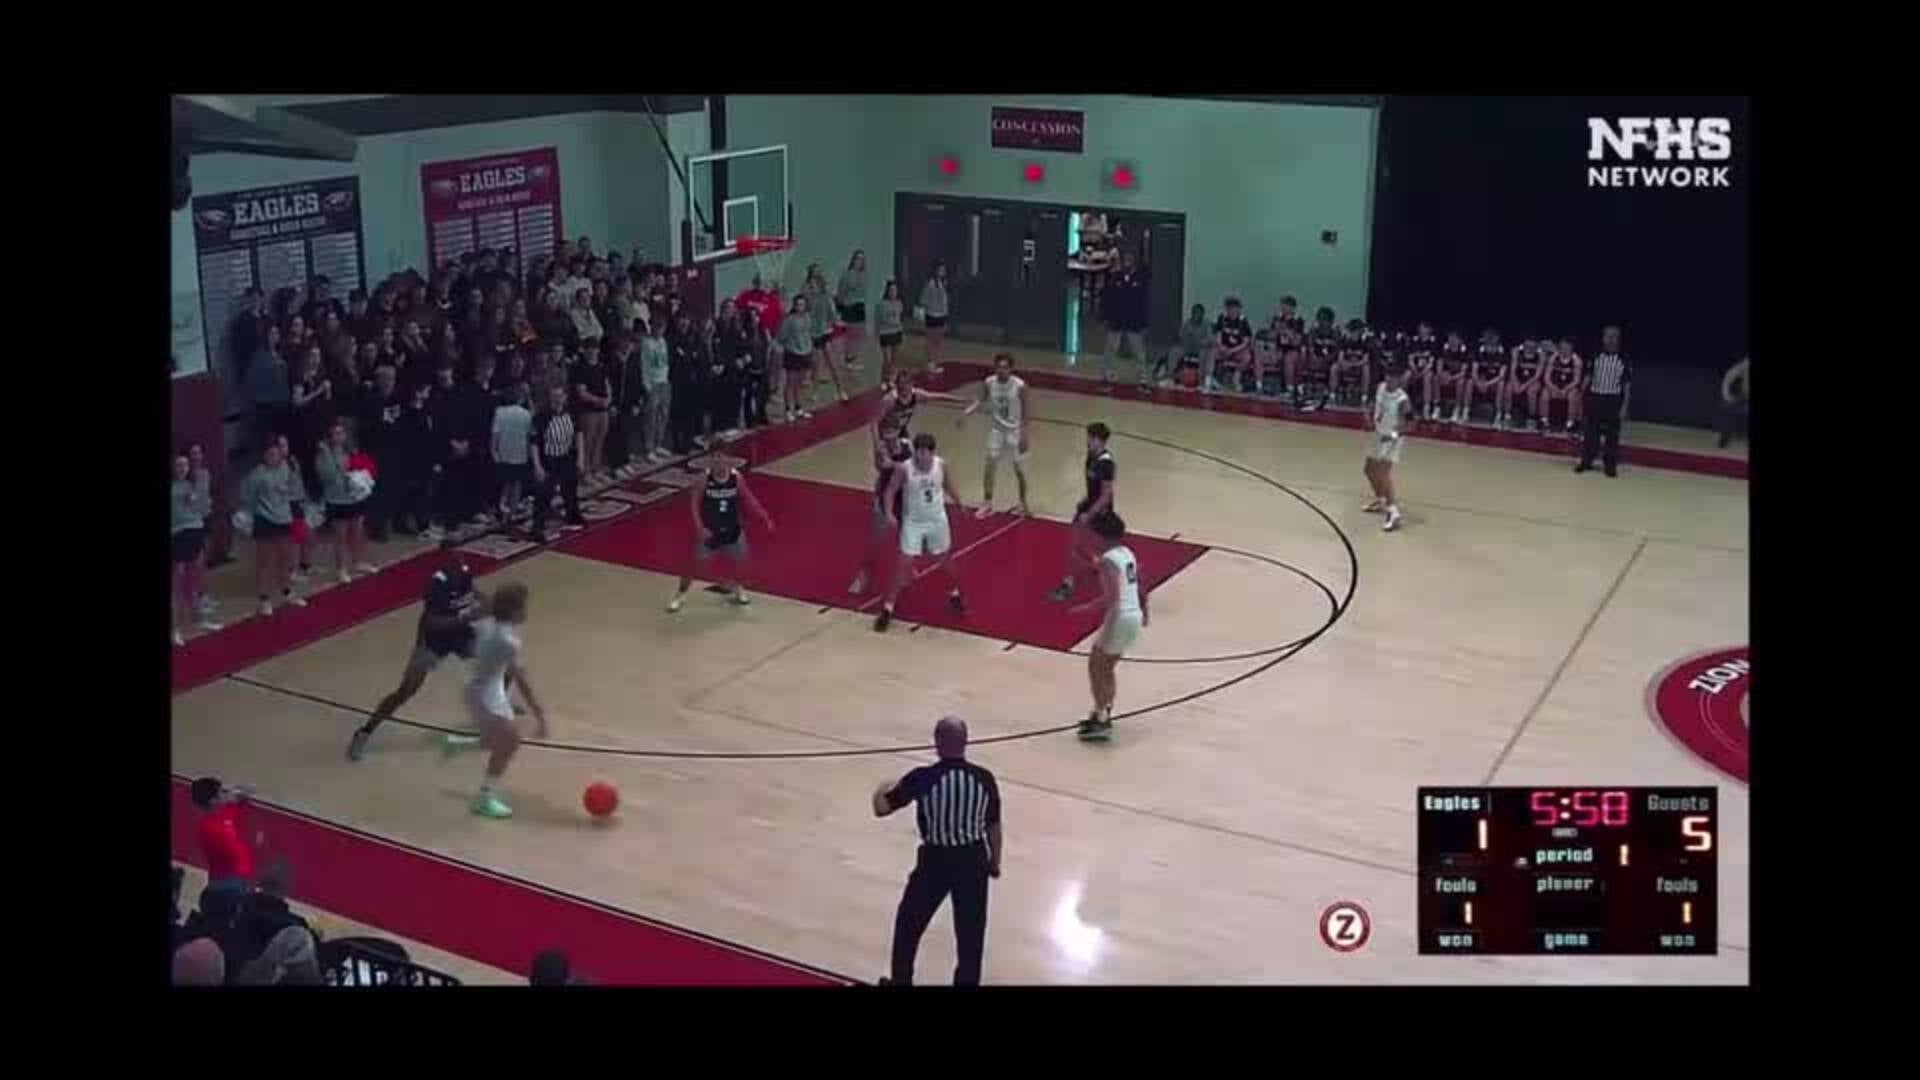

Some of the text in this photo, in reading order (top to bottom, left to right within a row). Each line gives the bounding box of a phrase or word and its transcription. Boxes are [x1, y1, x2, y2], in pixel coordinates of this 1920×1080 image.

[460, 166, 525, 193] EAGLES
[233, 192, 320, 226] EAGLES
[1688, 658, 1750, 694] ZION
